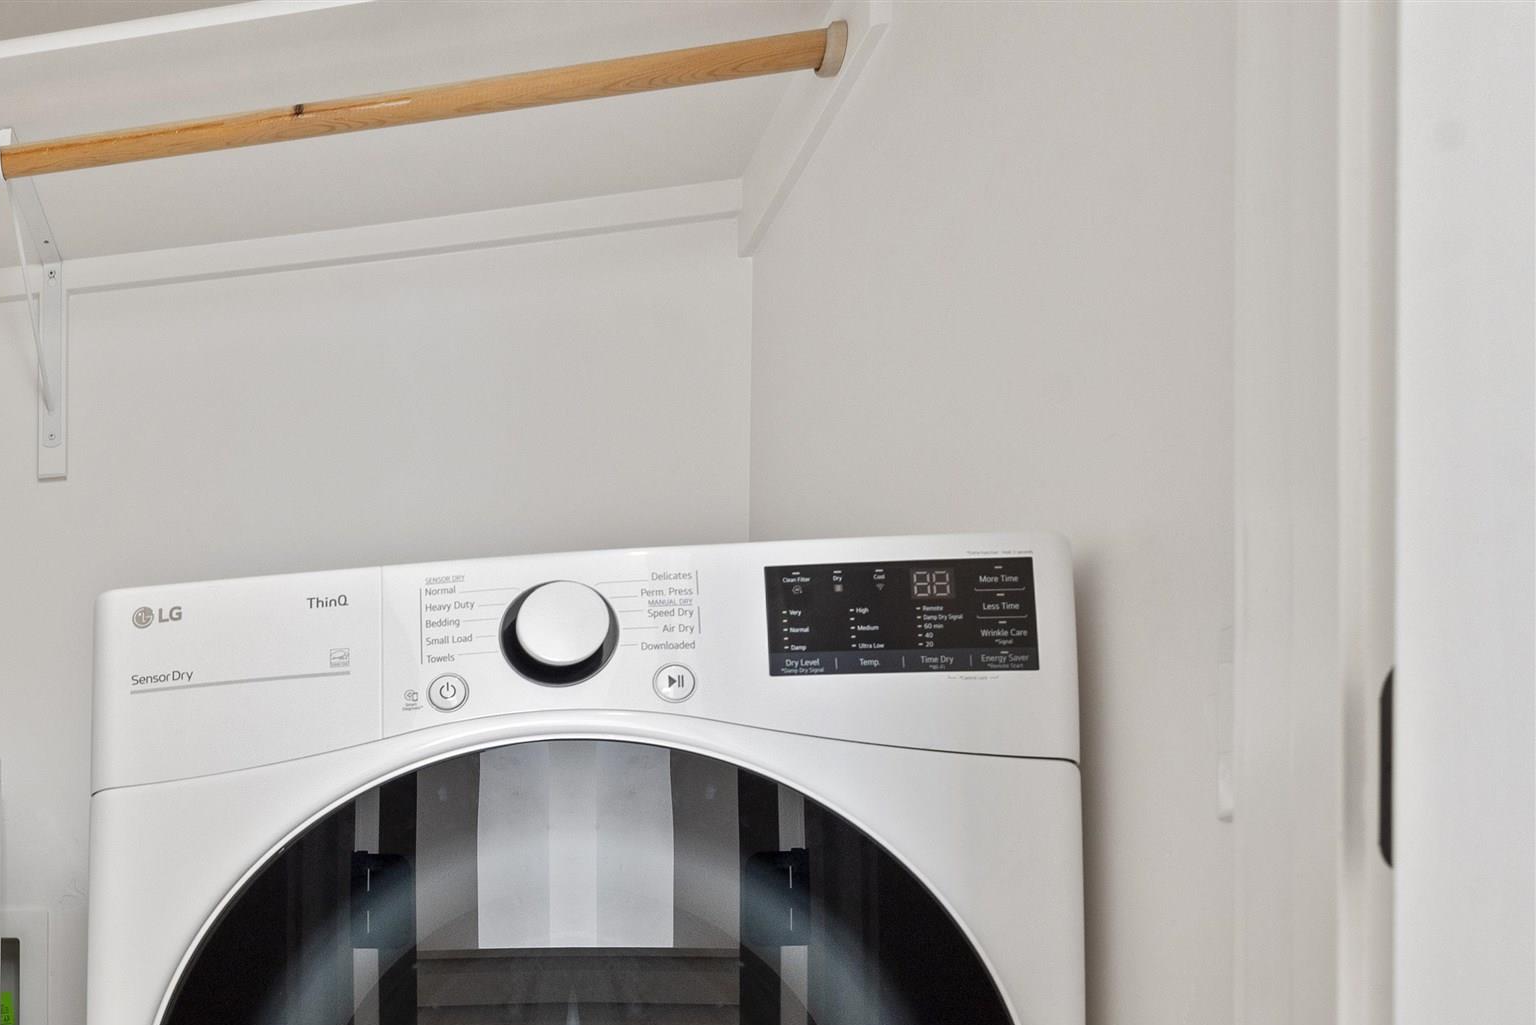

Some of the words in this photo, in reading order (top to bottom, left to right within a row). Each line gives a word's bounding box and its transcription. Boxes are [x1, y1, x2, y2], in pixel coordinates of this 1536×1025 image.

[651, 571, 693, 581] Delicates
[979, 575, 999, 583] More
[1000, 574, 1019, 582] Time
[425, 586, 456, 596] Normal
[640, 588, 666, 597] Perm.
[669, 587, 693, 596] Press
[306, 594, 349, 609] ThinQ
[425, 603, 451, 612] Heavy
[454, 601, 475, 610] Duty
[983, 602, 1000, 610] Less
[647, 608, 675, 619] Speed
[678, 608, 694, 618] Dry
[425, 618, 460, 629] Bedding
[662, 624, 675, 632] Air
[678, 624, 695, 634] Dry
[980, 629, 1008, 637] Wrinkle
[426, 636, 450, 646] Small
[452, 634, 473, 643] Load
[640, 640, 695, 650] Downloaded
[426, 653, 455, 664] Towels
[785, 659, 799, 668] Dry
[800, 658, 820, 666] Level
[940, 655, 954, 664] Dry
[981, 654, 1007, 663] Energy
